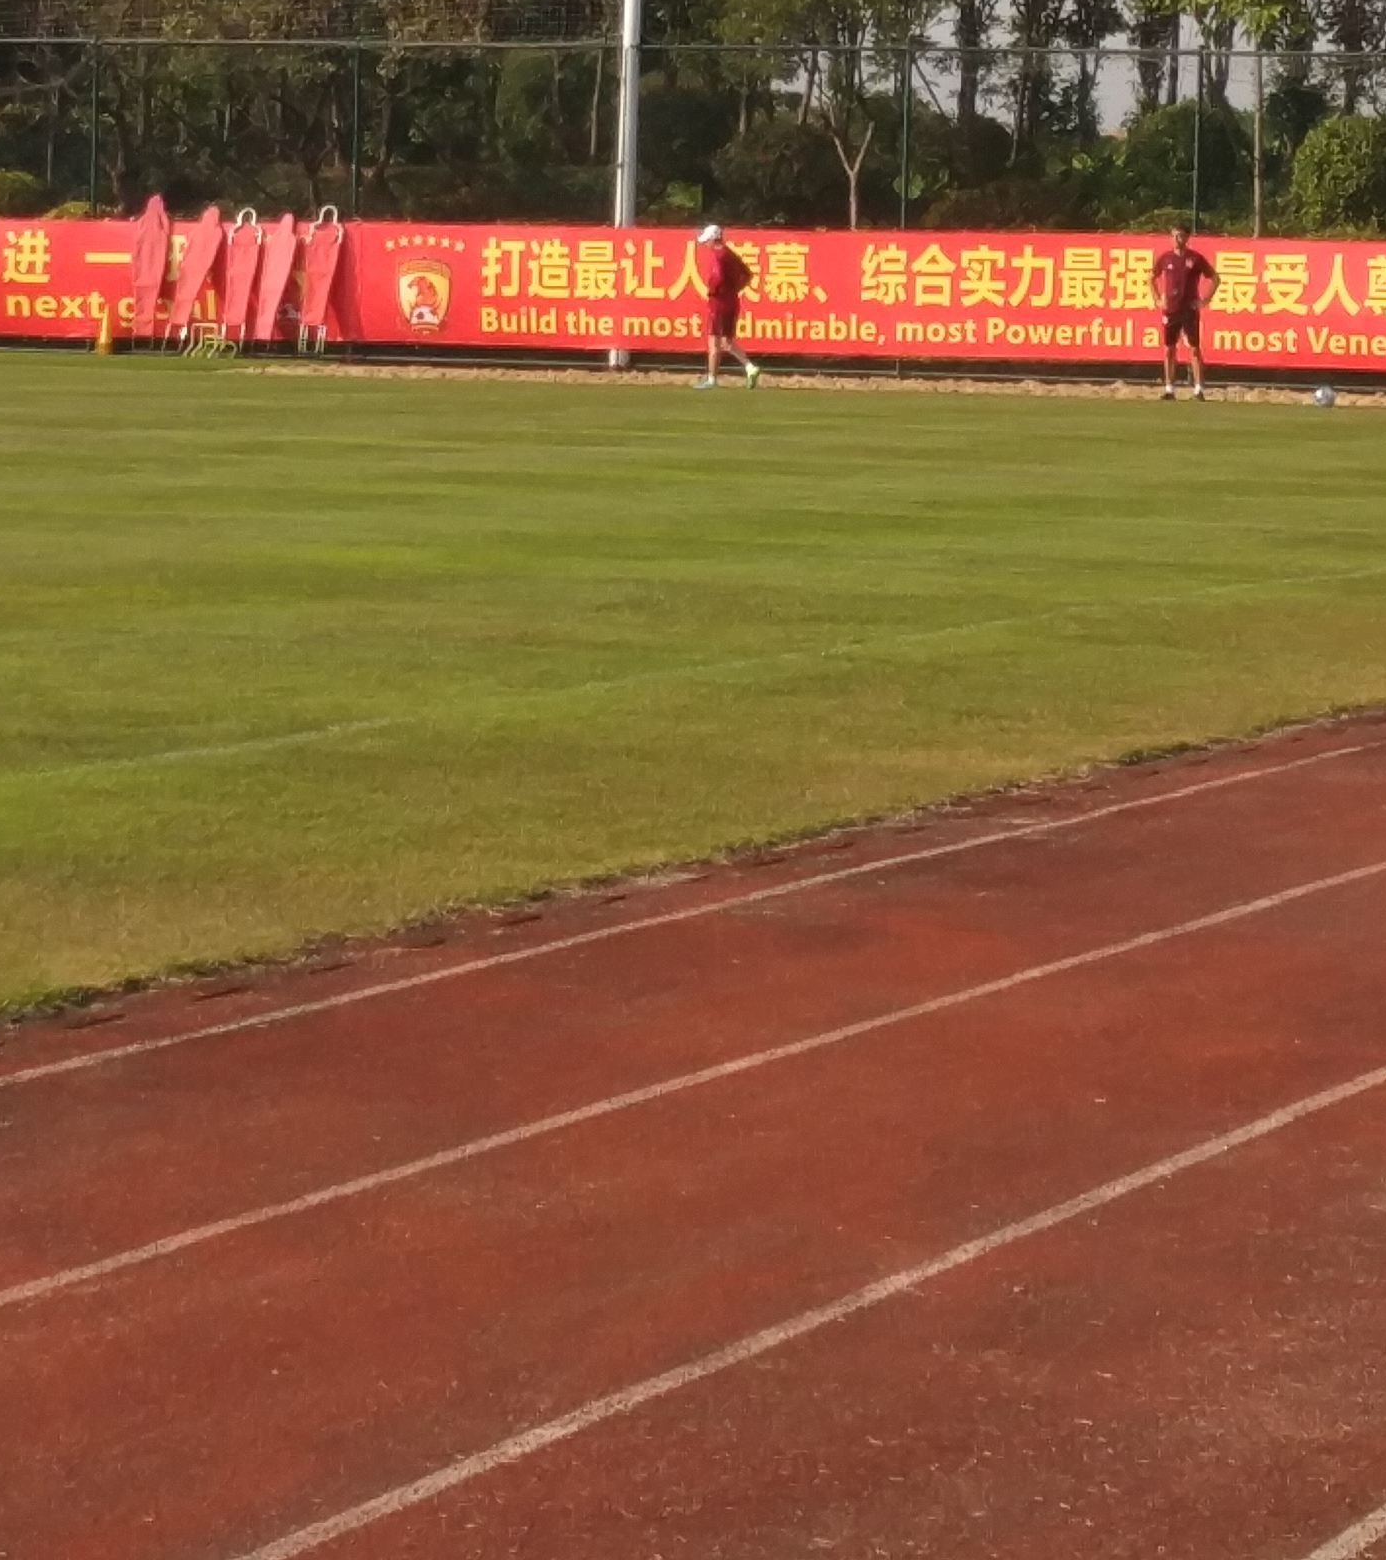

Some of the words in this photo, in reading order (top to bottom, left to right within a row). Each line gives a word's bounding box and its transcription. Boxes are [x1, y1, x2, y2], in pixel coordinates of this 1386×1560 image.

[4, 290, 105, 320] next
[479, 305, 559, 336] Build
[564, 306, 614, 338] the
[621, 312, 703, 338] most
[734, 310, 886, 347] dmirable,
[895, 320, 976, 345] most
[984, 316, 1136, 348] Powerful
[1213, 327, 1299, 355] most
